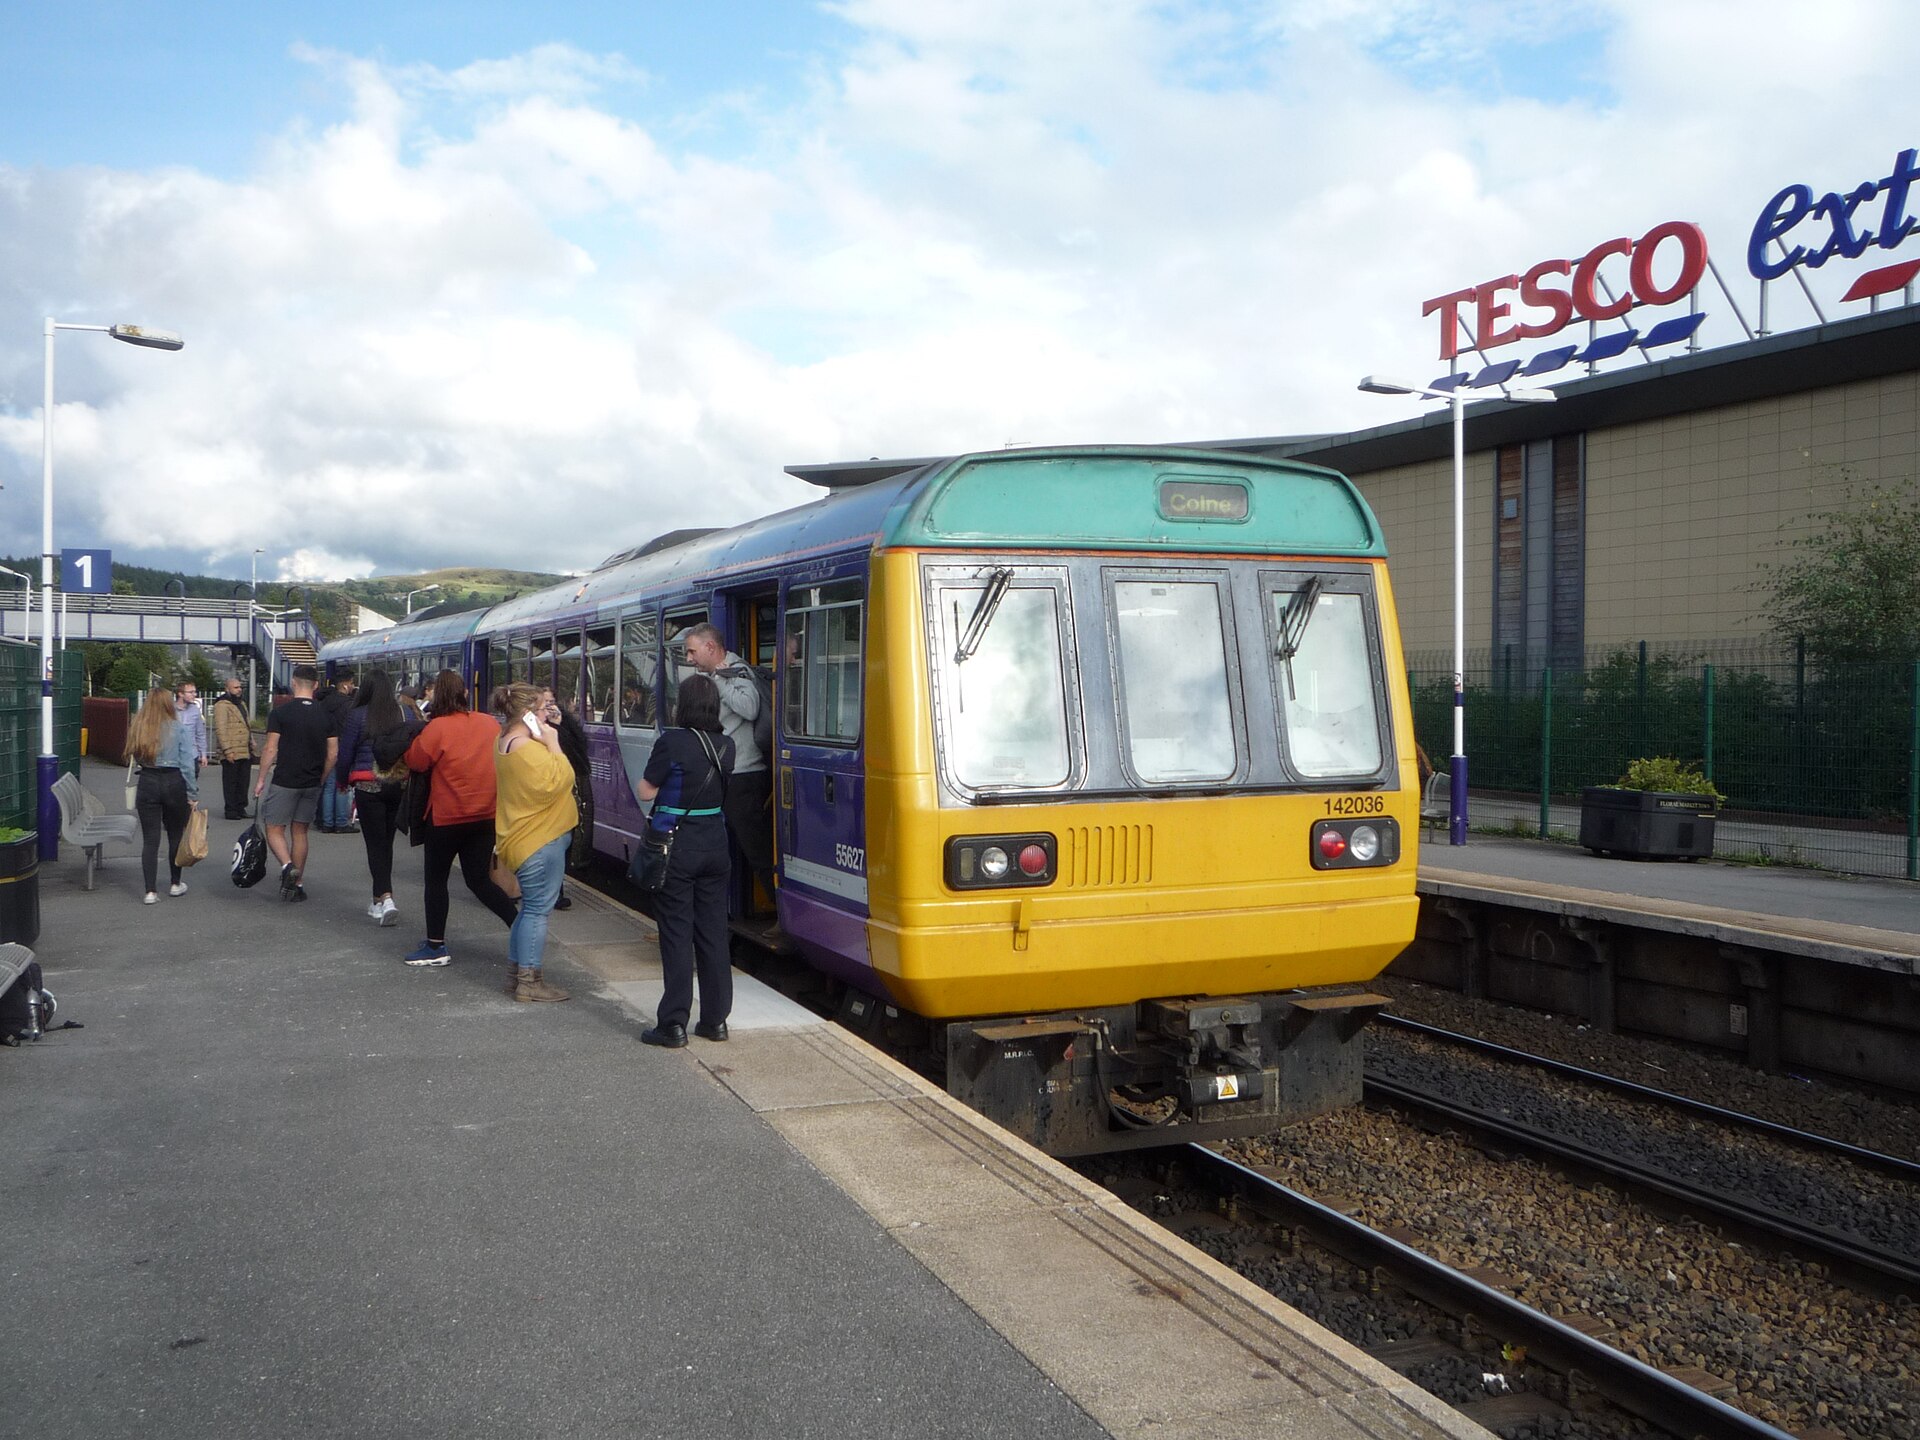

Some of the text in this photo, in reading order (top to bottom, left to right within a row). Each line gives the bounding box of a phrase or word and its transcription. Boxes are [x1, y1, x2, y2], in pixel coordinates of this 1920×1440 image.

[1422, 221, 1708, 361] TESCO
[1170, 494, 1231, 513] Colne
[74, 555, 92, 588] 1
[1324, 796, 1384, 815] 142036
[836, 843, 865, 871] 55627
